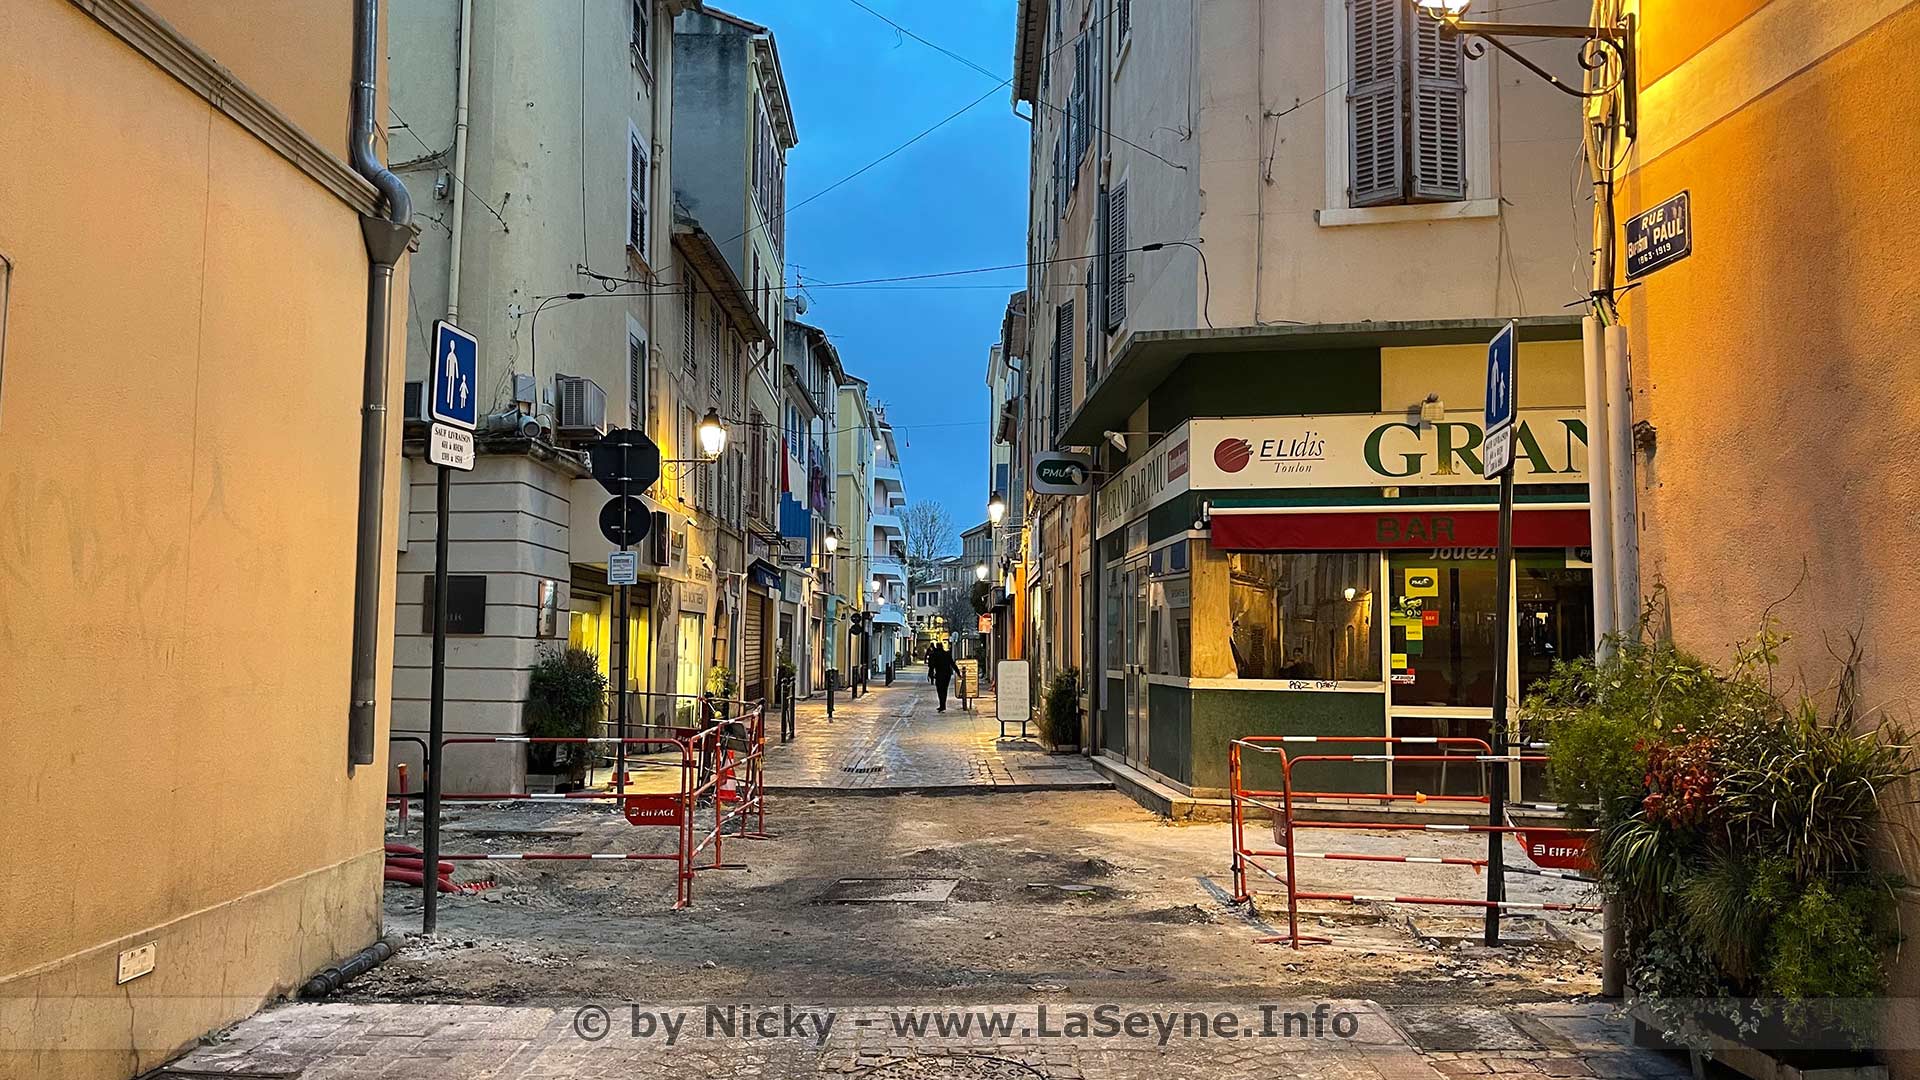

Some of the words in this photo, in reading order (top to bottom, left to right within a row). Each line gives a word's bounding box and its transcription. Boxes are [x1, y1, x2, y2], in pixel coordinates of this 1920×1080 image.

[1641, 207, 1664, 231] RUE
[1653, 218, 1684, 245] PAUL
[1259, 431, 1325, 458] ELIdis
[1363, 419, 1590, 478] GRAN
[1042, 467, 1066, 478] PMU
[1274, 461, 1312, 473] Toulon
[1107, 479, 1129, 522] GRAND
[1130, 468, 1147, 508] BAR
[1147, 451, 1167, 499] PMU
[1376, 517, 1455, 542] BAR
[1548, 847, 1580, 857] EIFFA
